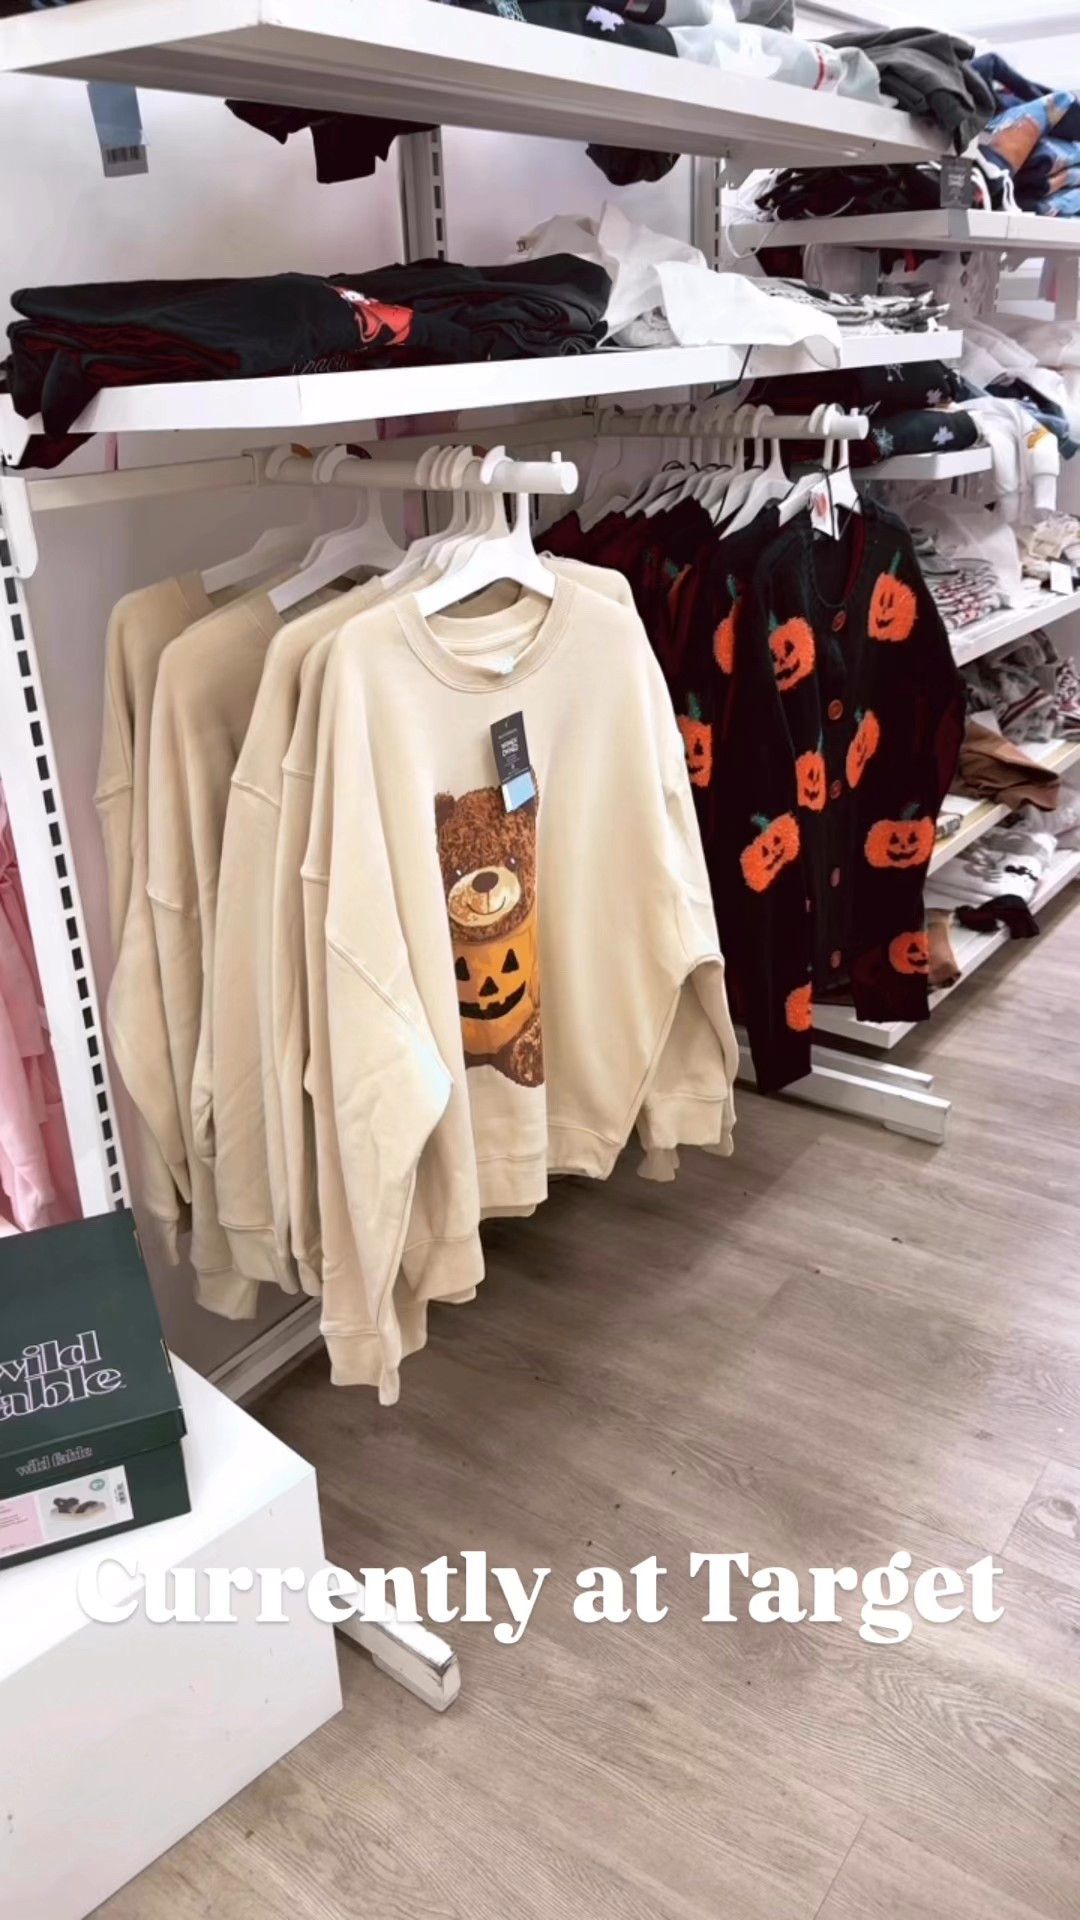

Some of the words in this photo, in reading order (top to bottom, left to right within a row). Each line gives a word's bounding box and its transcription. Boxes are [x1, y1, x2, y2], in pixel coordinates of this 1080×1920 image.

[0, 1366, 122, 1420] able
[16, 1456, 51, 1476] wild
[51, 1446, 93, 1468] fable
